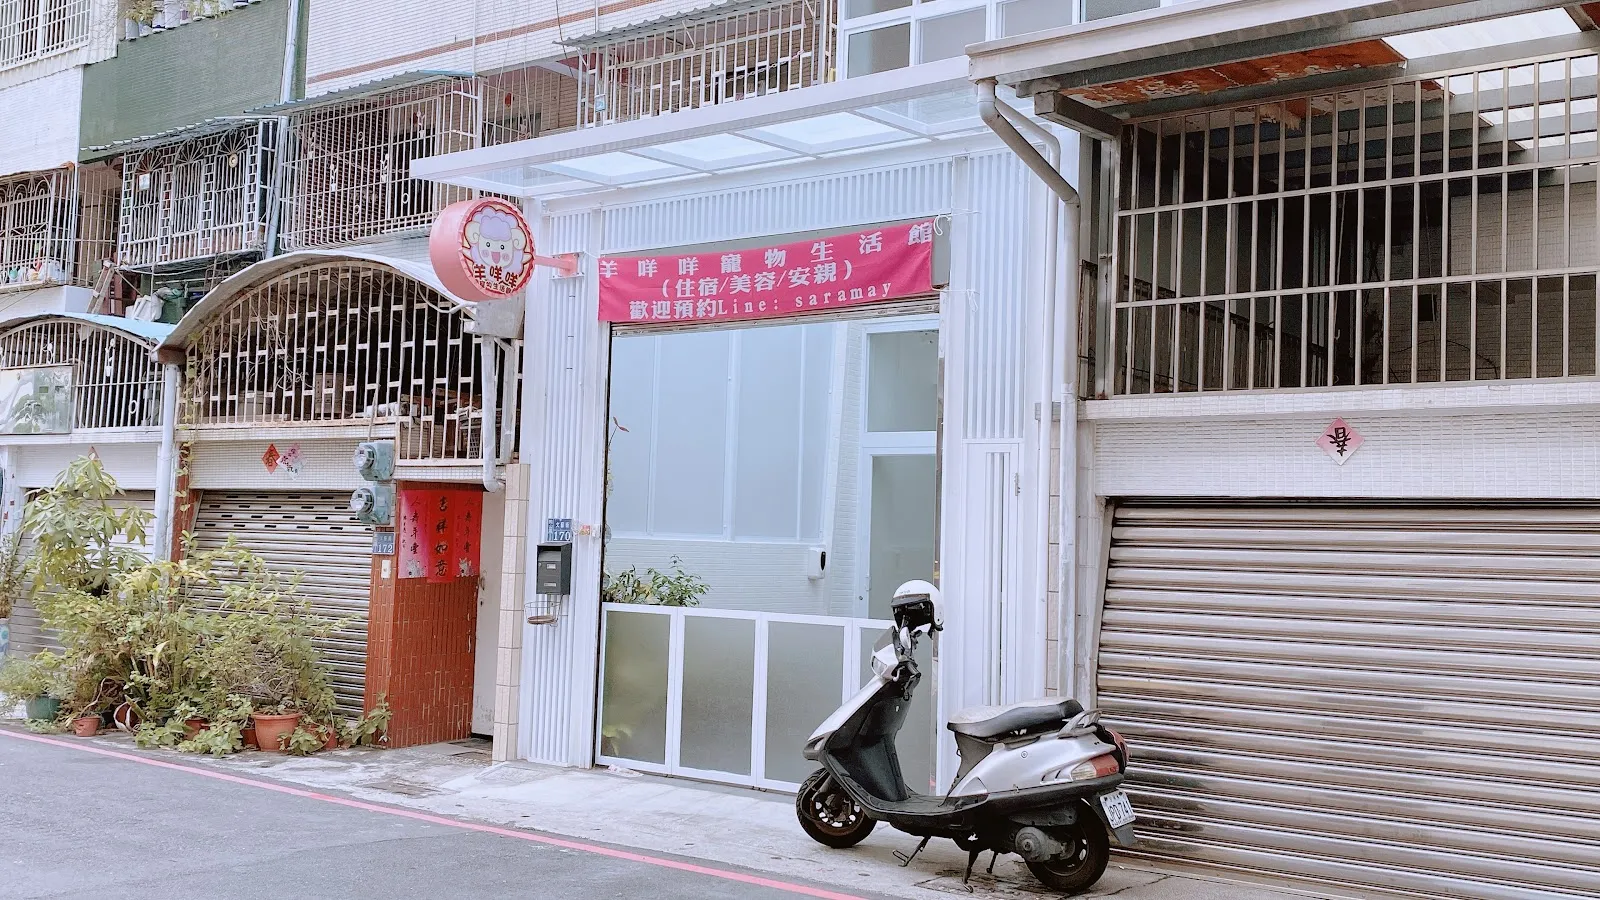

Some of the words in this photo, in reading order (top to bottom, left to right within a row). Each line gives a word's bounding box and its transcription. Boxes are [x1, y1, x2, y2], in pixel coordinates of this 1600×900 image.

[600, 222, 933, 278] 羊咩咩寵物生活館
[473, 264, 518, 288] 羊咩咩
[795, 282, 891, 307] saramay
[1326, 427, 1351, 457] 春
[553, 531, 570, 541] 170
[378, 544, 393, 553] 172
